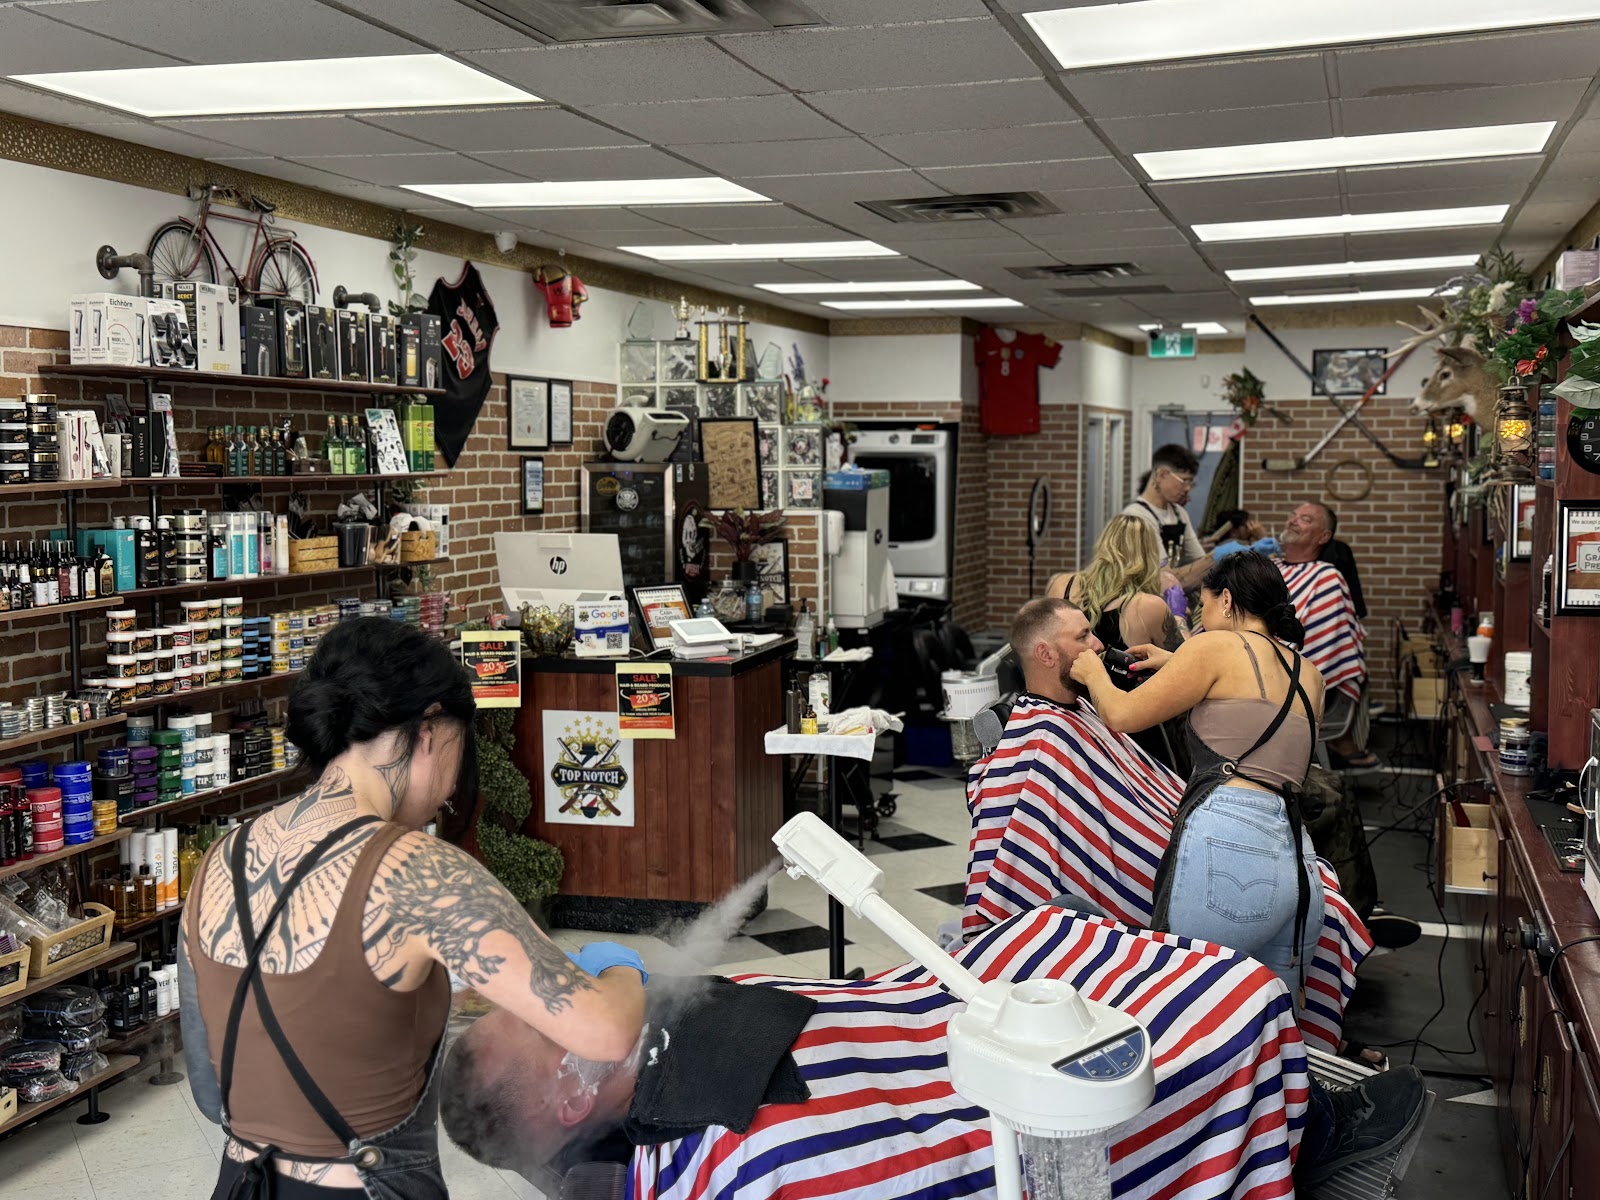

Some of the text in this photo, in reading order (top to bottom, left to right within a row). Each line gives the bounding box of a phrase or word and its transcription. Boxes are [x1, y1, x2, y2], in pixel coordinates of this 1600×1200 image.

[1001, 361, 1010, 377] 8
[1585, 421, 1594, 429] 10
[1580, 433, 1589, 441] 9
[1584, 444, 1592, 452] 8
[1593, 453, 1600, 461] 7
[551, 556, 566, 575] hp
[591, 609, 625, 620] Google
[479, 642, 504, 651] SALE
[482, 662, 495, 672] 20
[632, 674, 657, 682] SALE
[636, 694, 648, 704] 20
[560, 768, 619, 784] TOP NOTCH
[155, 861, 163, 877] FUEL
